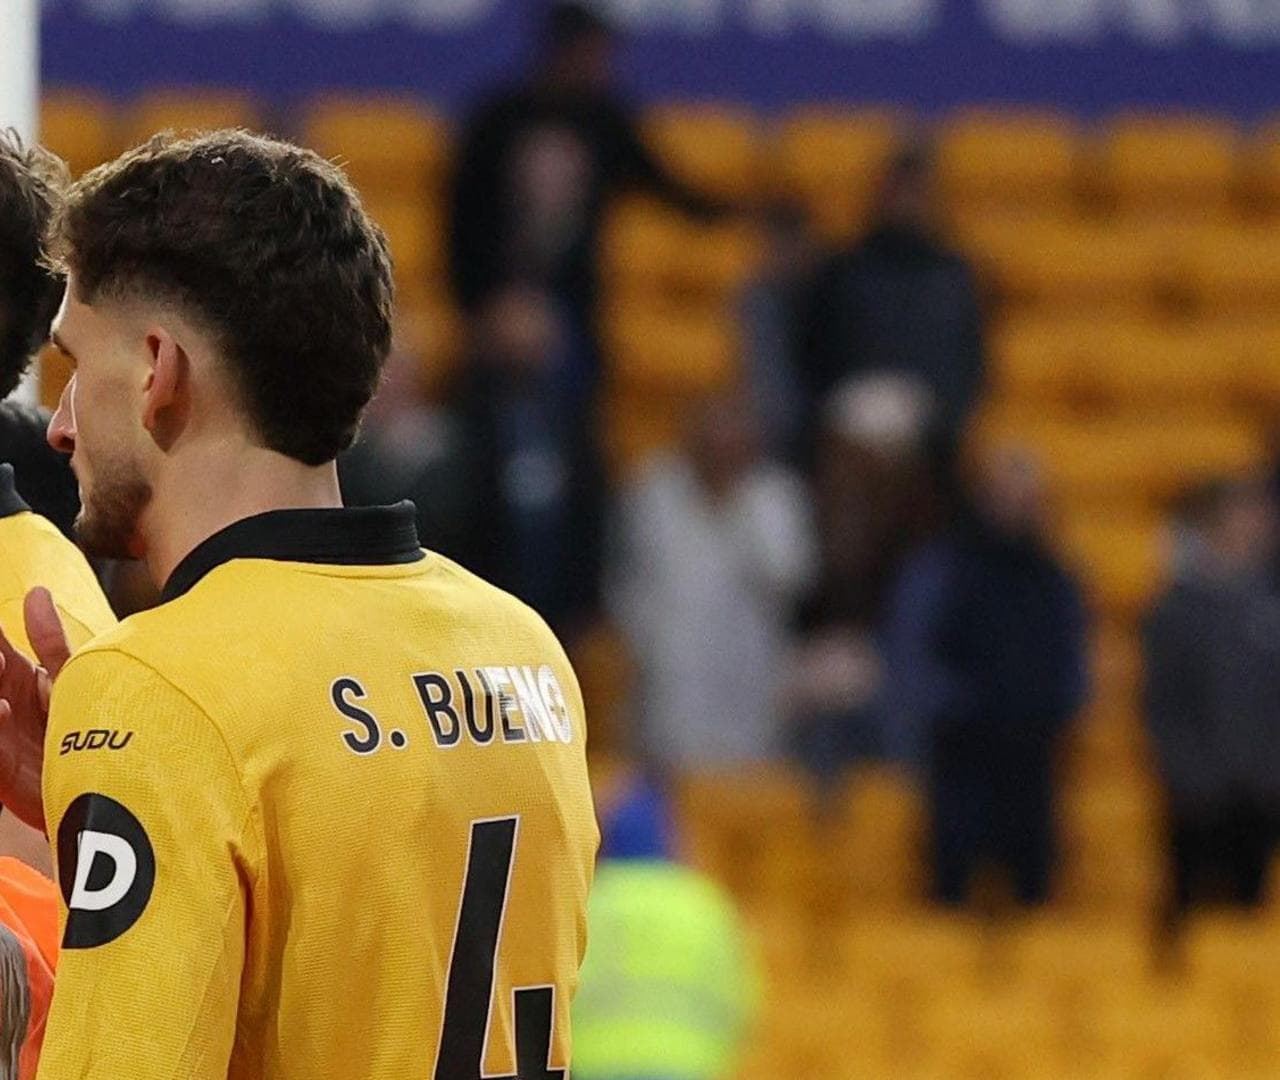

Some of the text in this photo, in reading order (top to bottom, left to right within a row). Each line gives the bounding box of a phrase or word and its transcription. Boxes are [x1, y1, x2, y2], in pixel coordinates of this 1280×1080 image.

[60, 729, 134, 756] SUDU
[330, 664, 572, 756] S. BUENO
[69, 829, 137, 911] D
